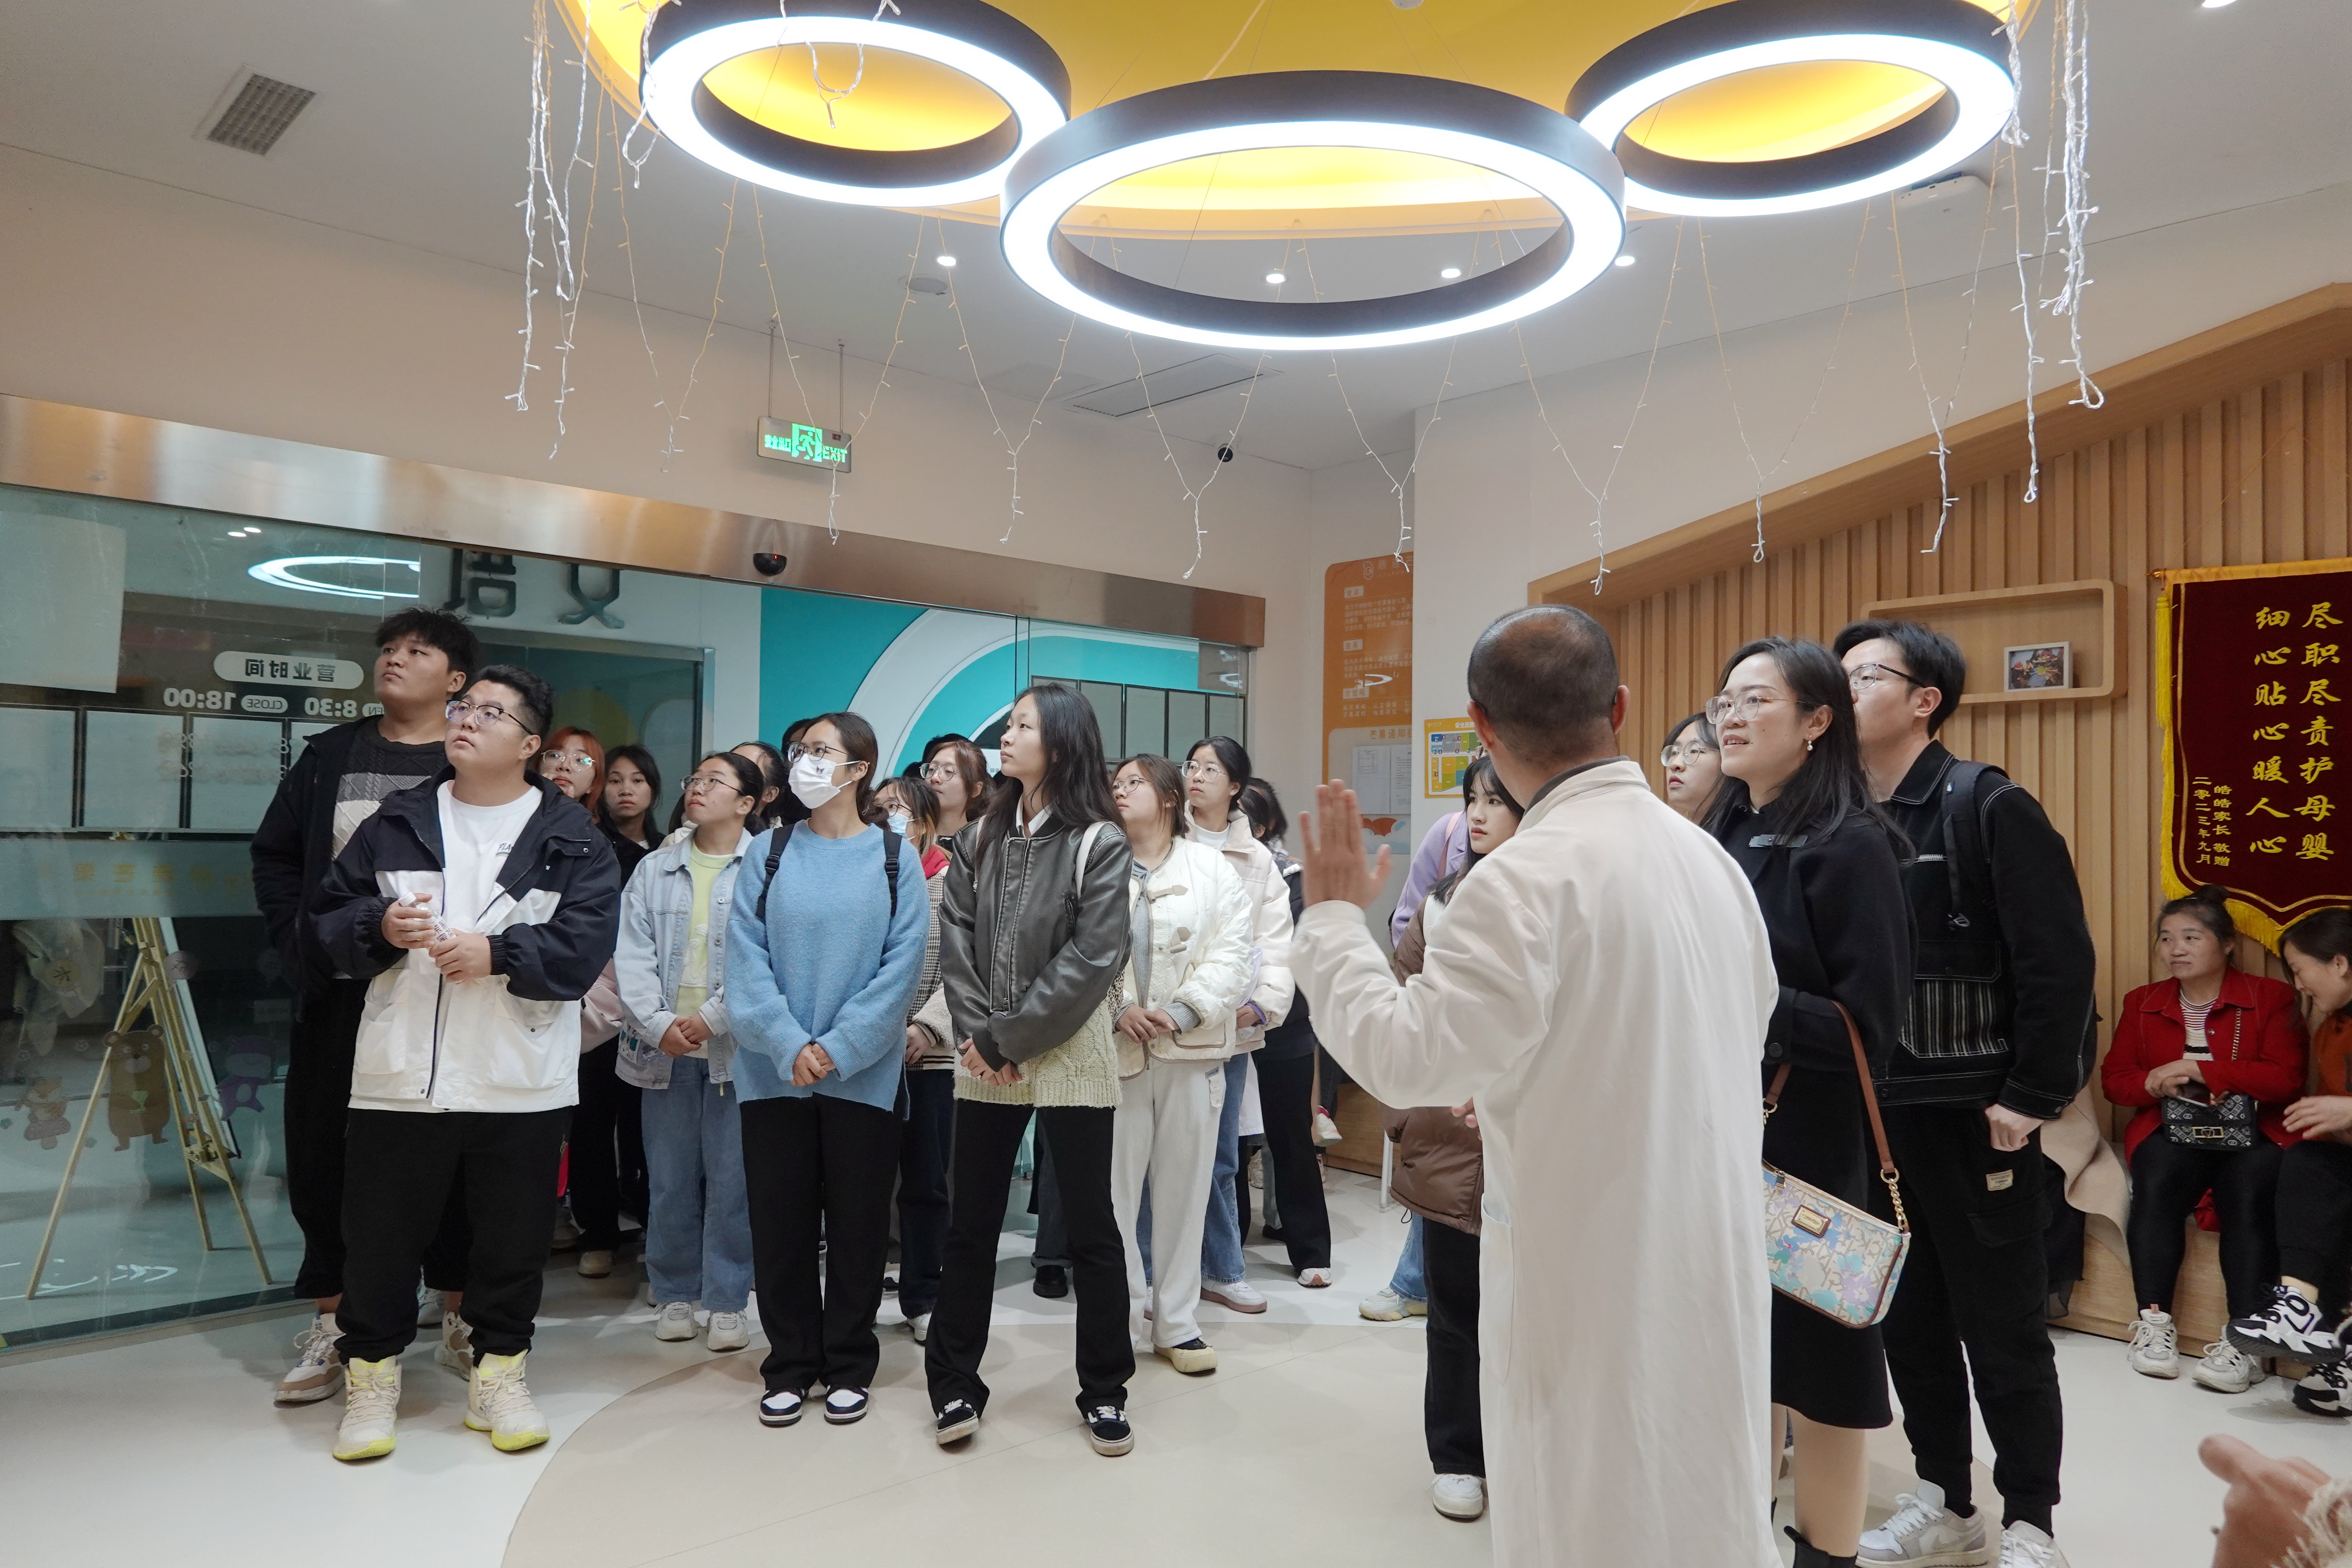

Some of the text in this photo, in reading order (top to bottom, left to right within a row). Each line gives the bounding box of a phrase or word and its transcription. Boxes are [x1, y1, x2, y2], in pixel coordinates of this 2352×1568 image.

[823, 446, 847, 463] EXIT
[2245, 606, 2291, 854] 细心贴心暖人心
[2294, 602, 2343, 860] 尽职尽责护母婴
[2193, 777, 2212, 864] 二零二三年九月
